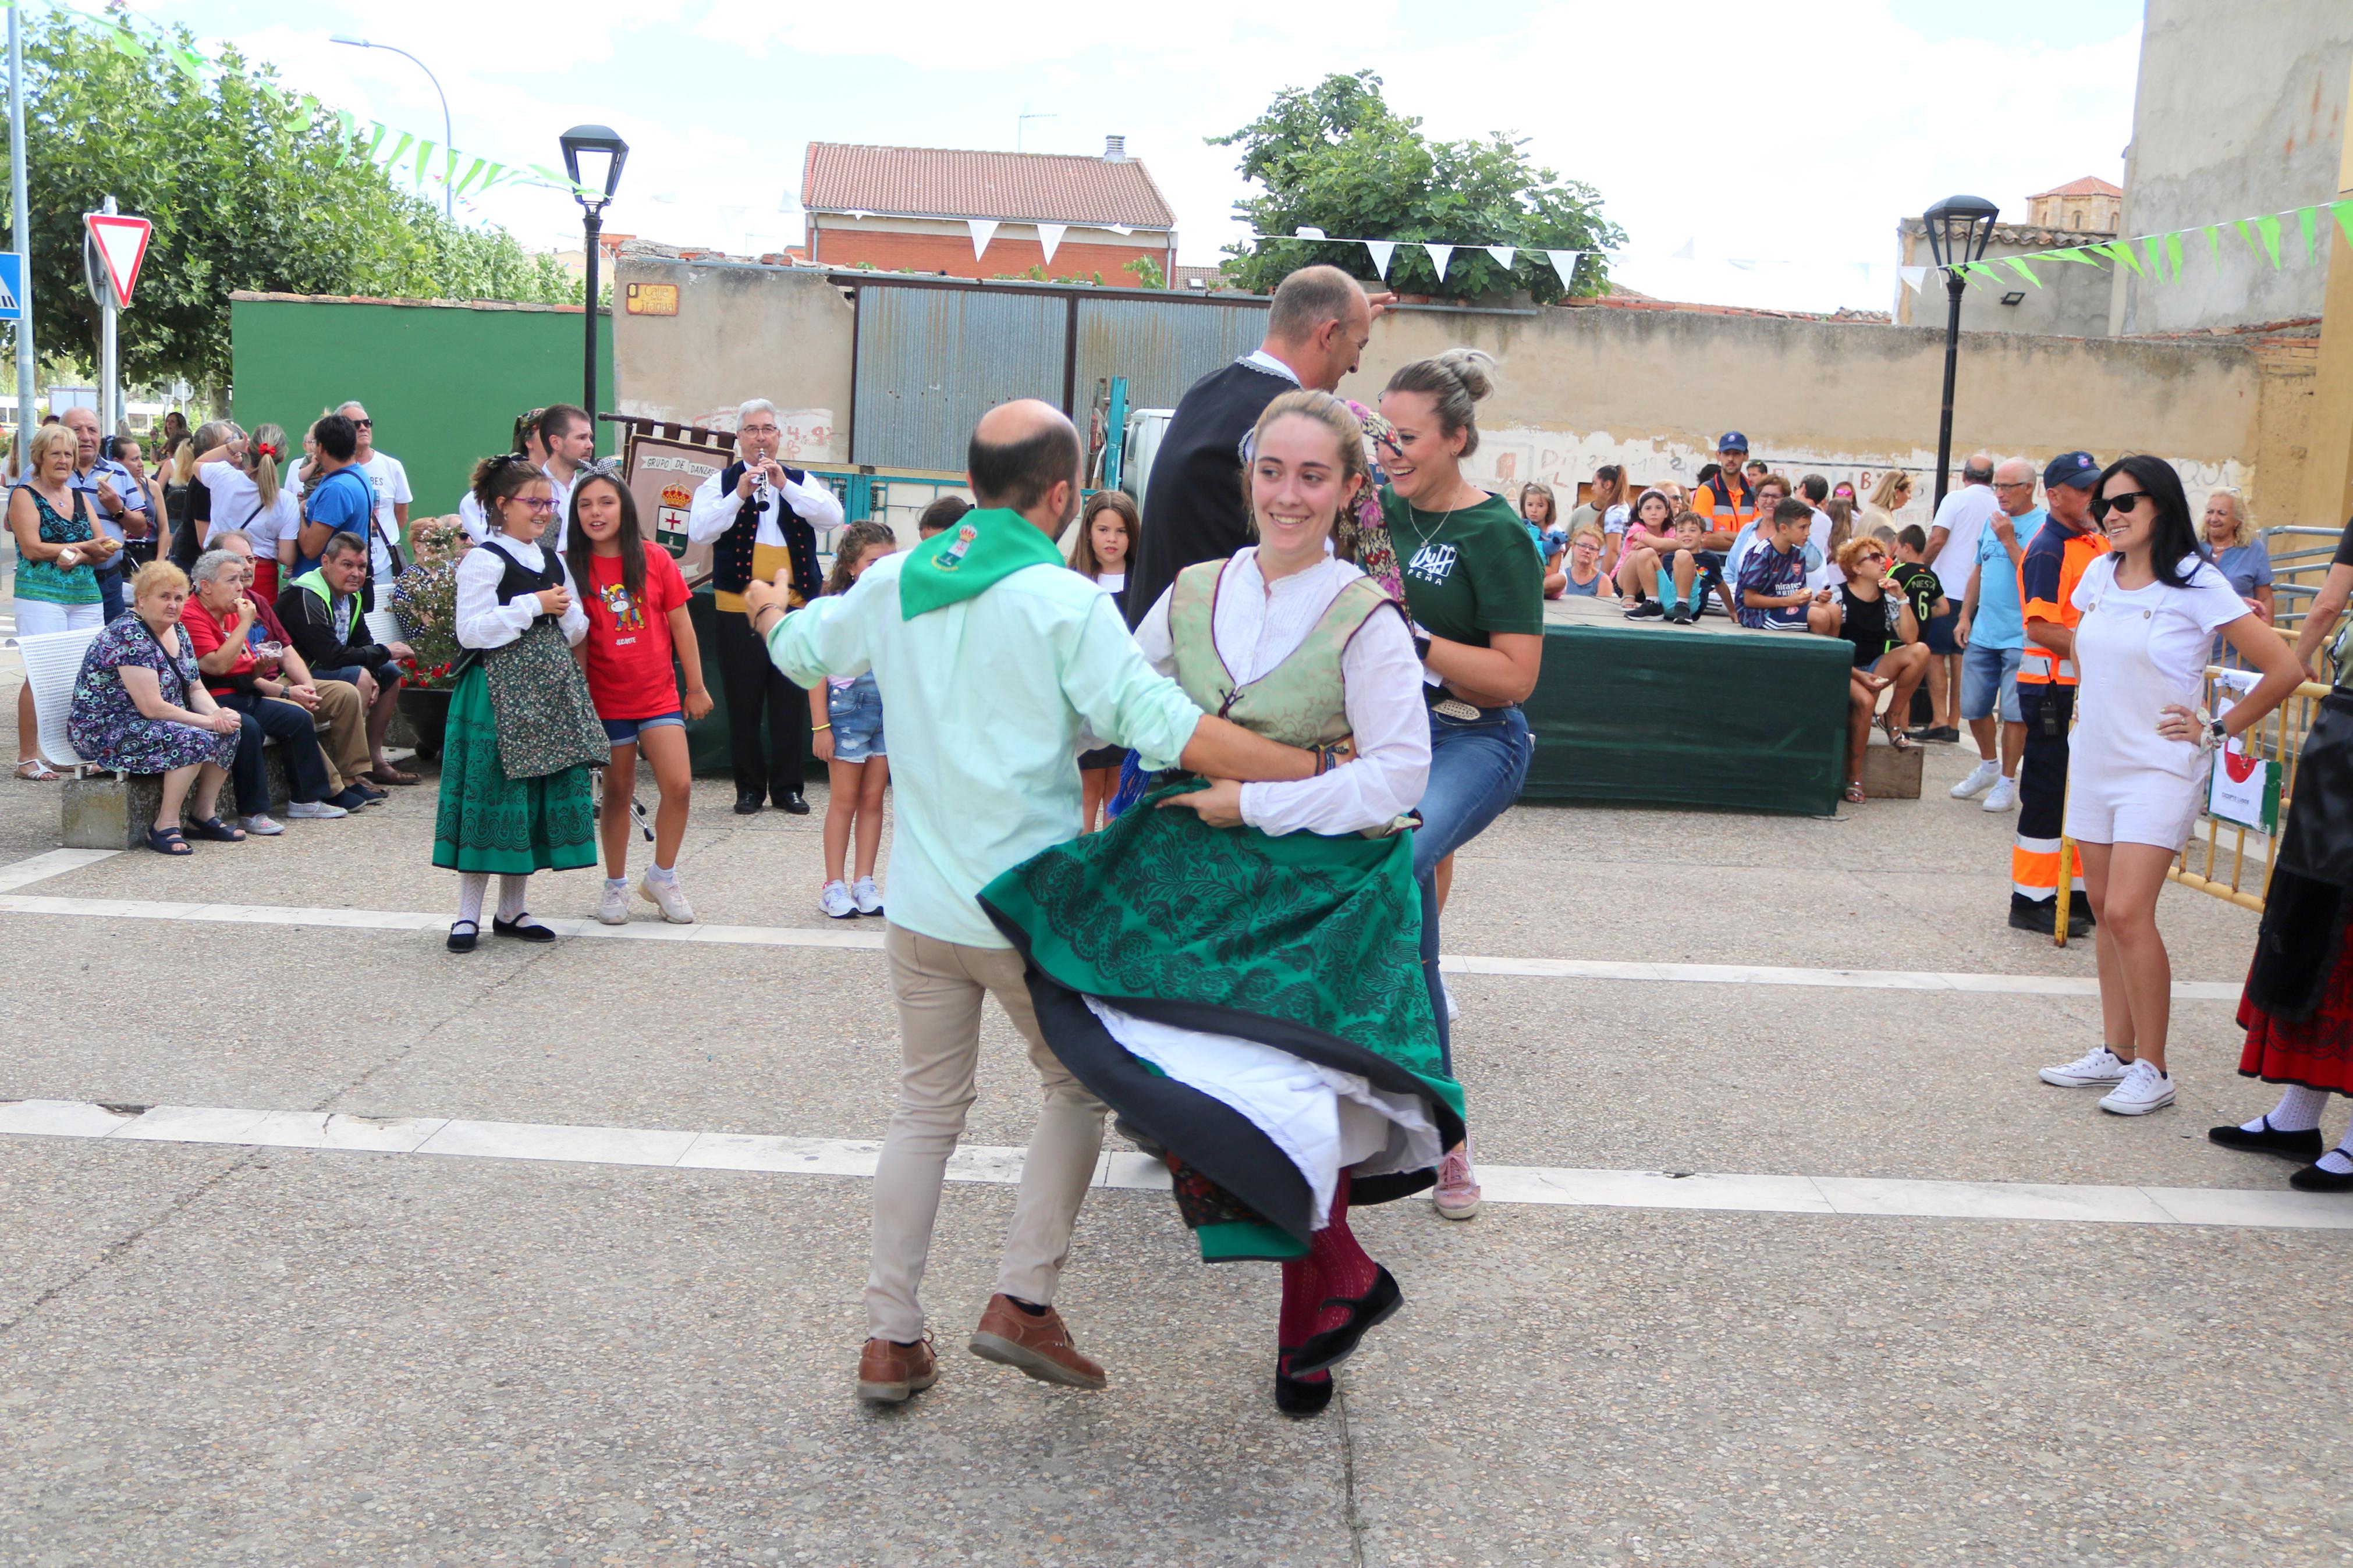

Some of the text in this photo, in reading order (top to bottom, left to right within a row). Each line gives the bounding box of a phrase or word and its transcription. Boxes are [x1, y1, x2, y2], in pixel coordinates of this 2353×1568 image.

[644, 285, 669, 297] Calle
[640, 300, 674, 314] Fragua
[647, 458, 715, 477] GRUPO DE DANZAS
[1410, 543, 1455, 574] Duff
[1407, 568, 1442, 586] PEÑA
[1918, 591, 1929, 621] 6
